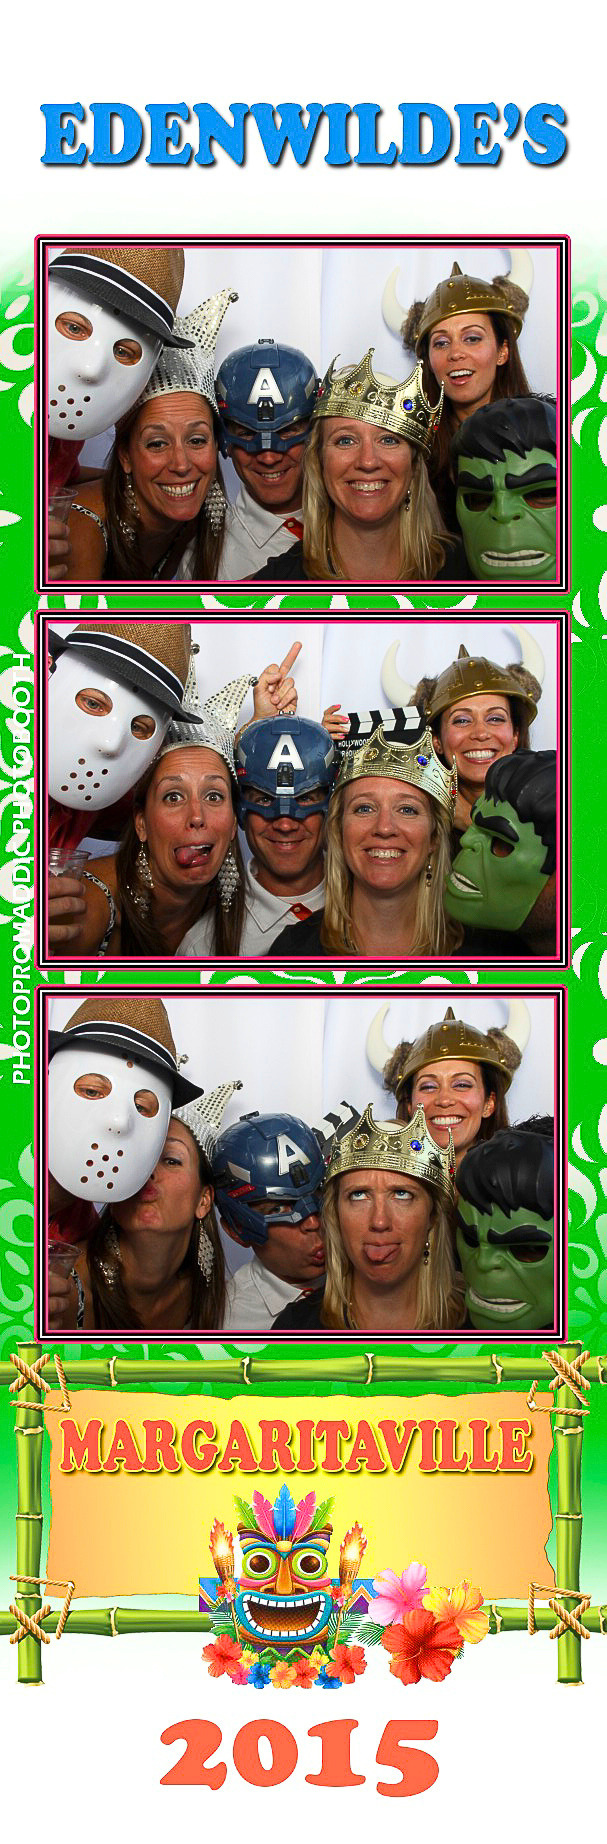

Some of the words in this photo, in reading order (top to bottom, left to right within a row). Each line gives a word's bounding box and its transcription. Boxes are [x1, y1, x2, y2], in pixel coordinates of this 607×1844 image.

[247, 367, 285, 404] A
[266, 734, 305, 770] A
[276, 1134, 311, 1176] A
